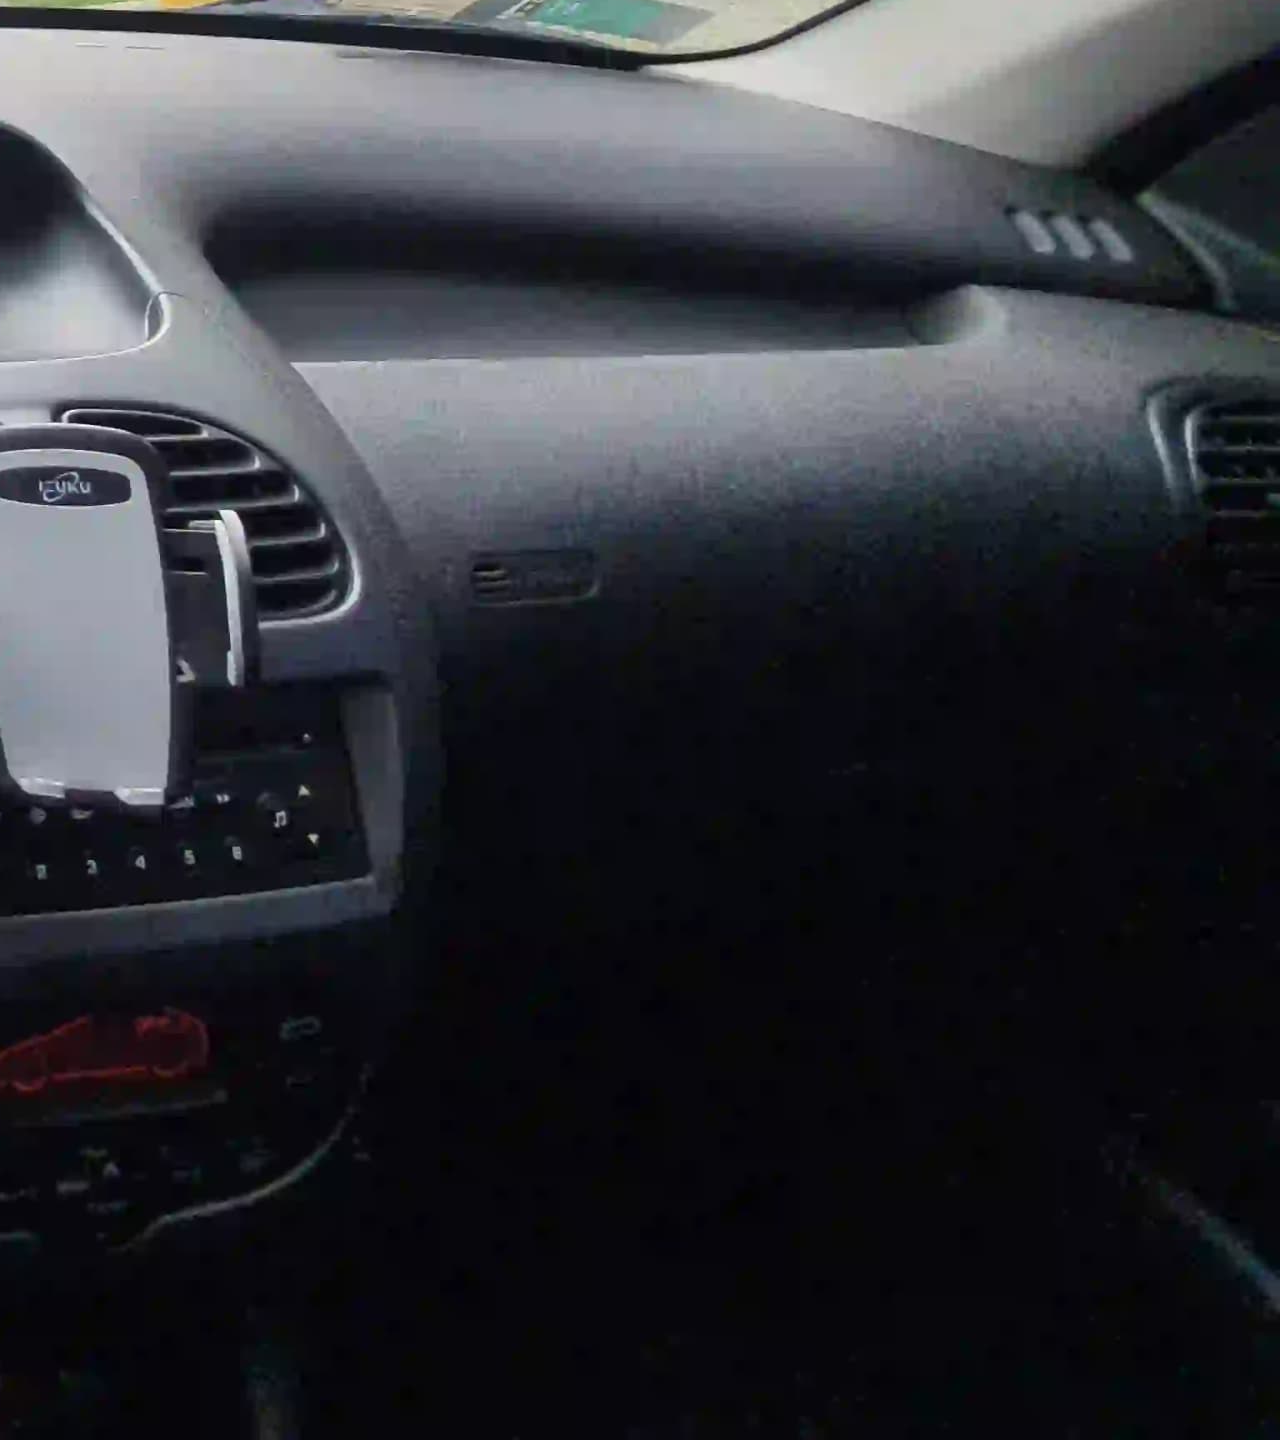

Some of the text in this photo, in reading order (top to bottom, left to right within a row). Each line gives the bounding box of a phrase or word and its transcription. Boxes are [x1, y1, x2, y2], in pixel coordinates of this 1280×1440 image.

[36, 864, 48, 880] 2
[87, 859, 98, 875] 3
[135, 854, 146, 870] 4
[185, 849, 197, 865] 5
[232, 844, 243, 860] 6
